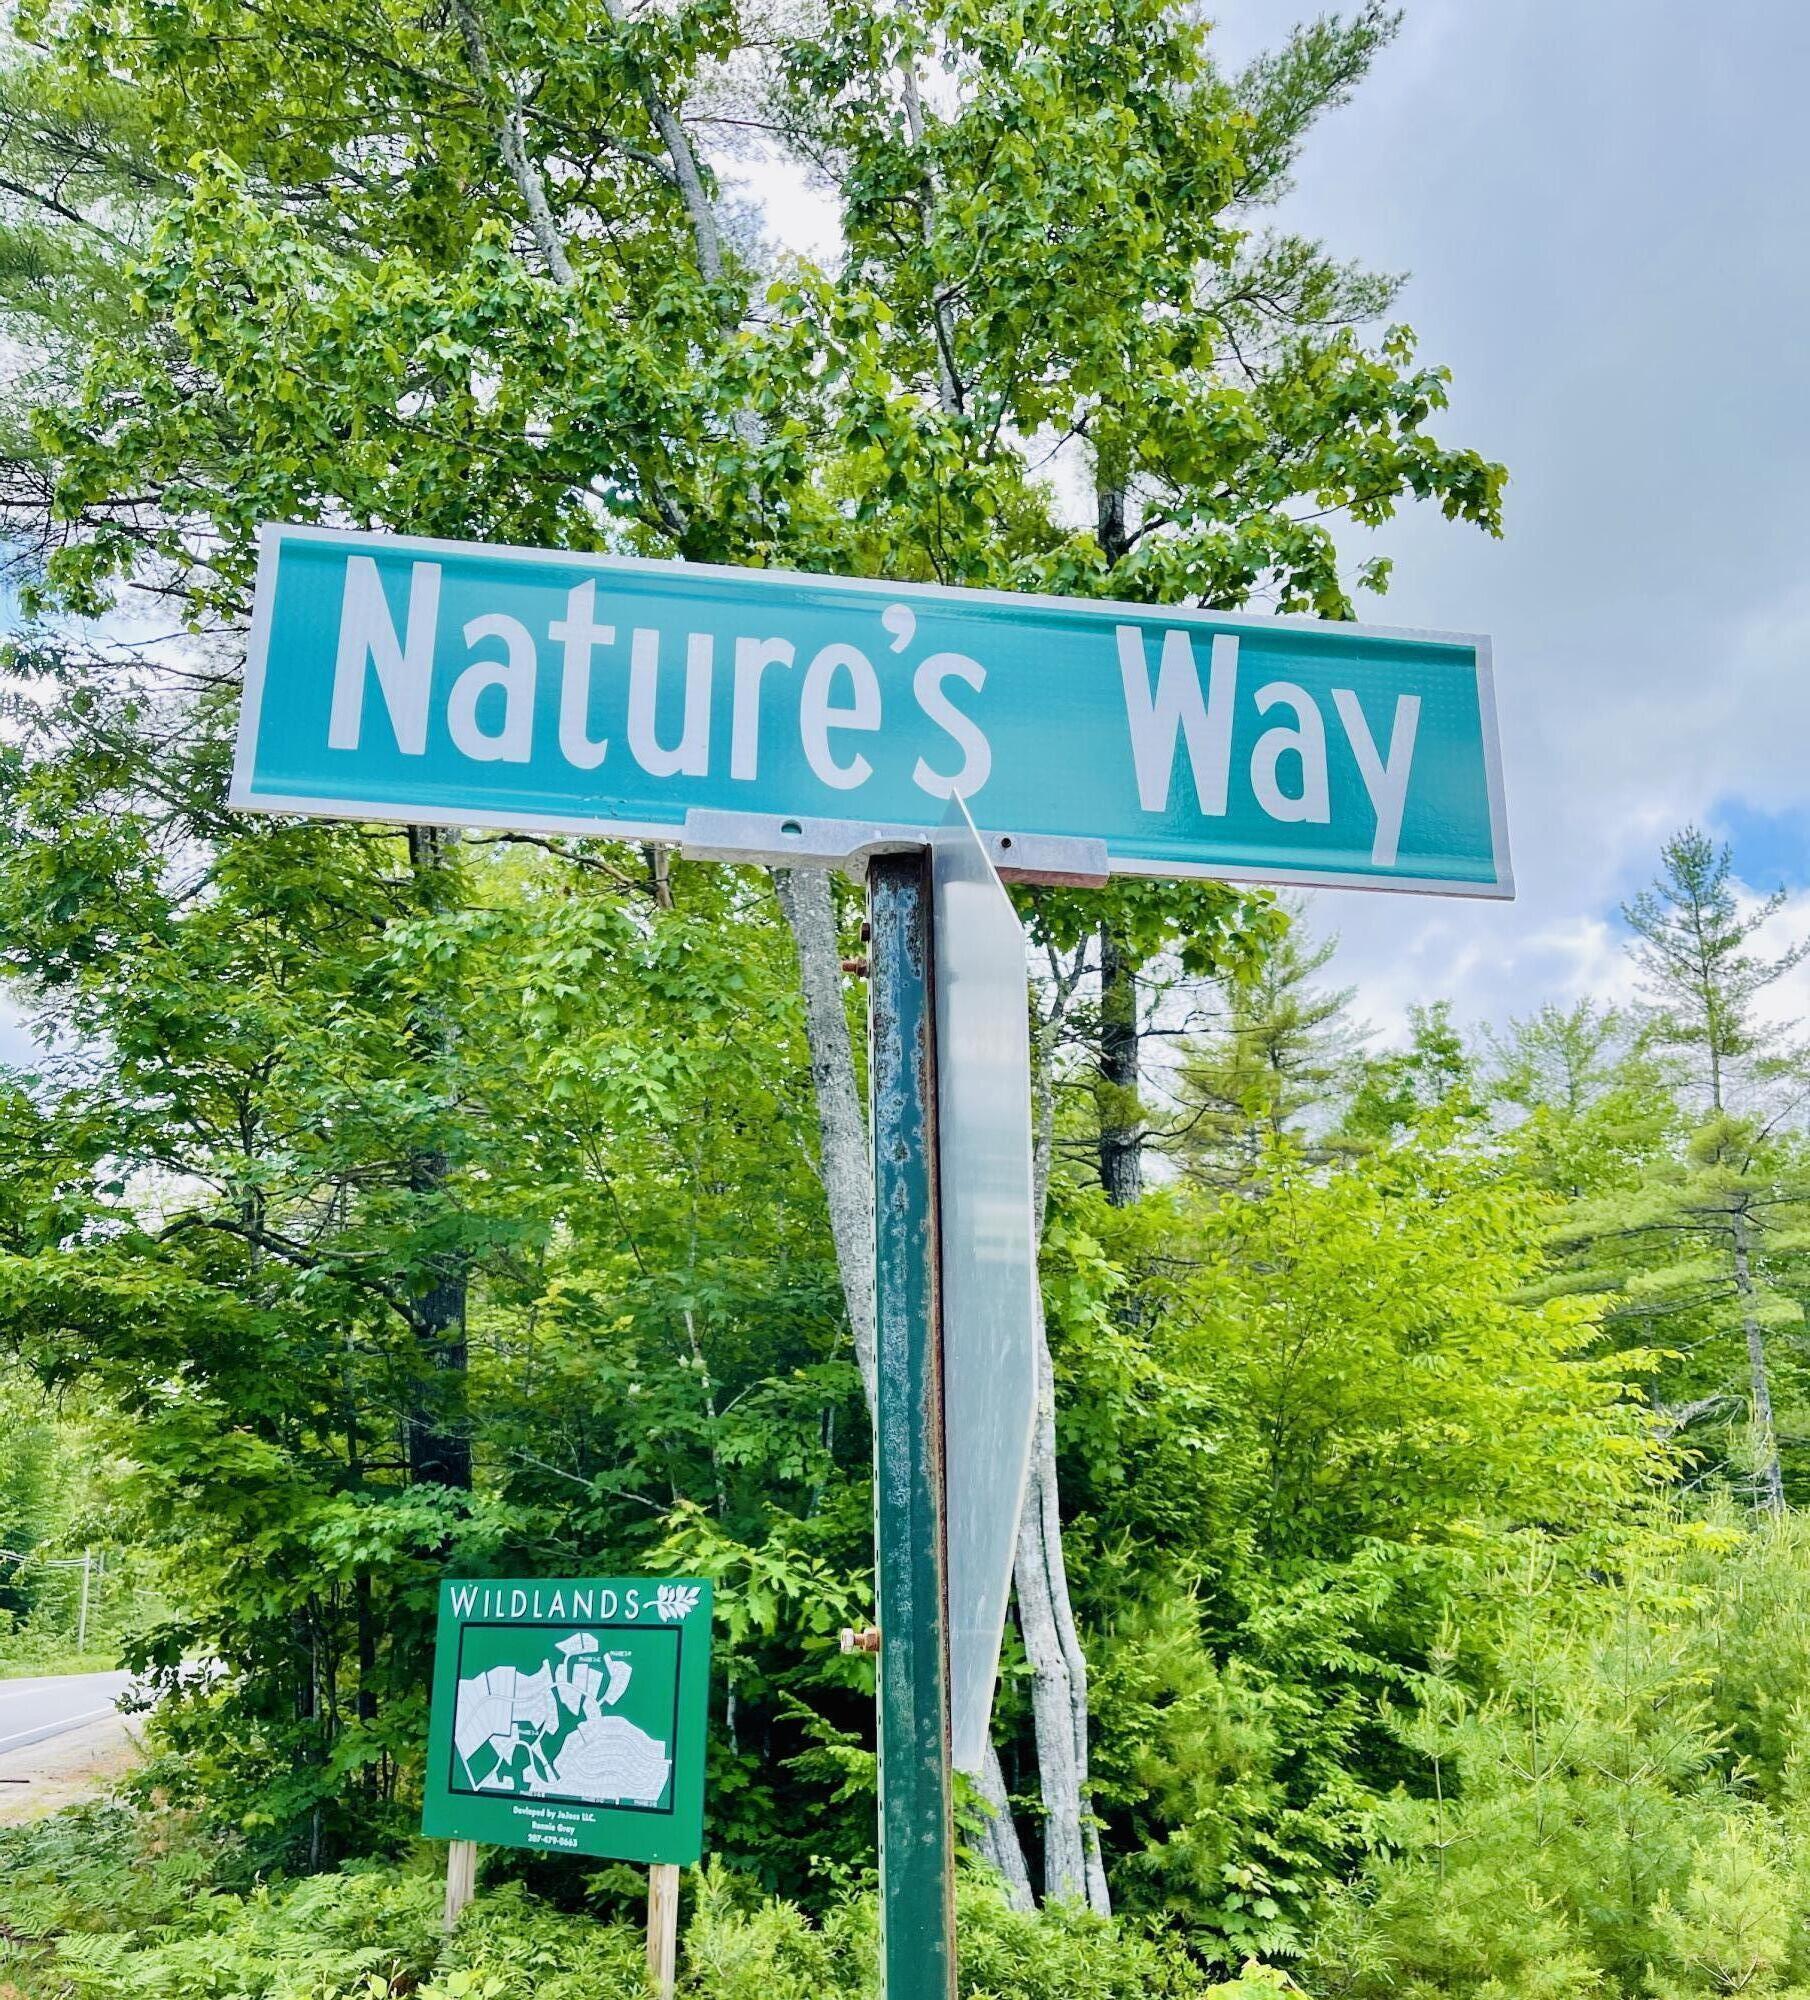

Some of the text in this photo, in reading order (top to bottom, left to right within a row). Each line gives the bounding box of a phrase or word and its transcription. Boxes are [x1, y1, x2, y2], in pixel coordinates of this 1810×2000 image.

[328, 555, 1421, 866] Nature's Way
[450, 1584, 640, 1620] WILDLANDS
[545, 1808, 556, 1820] by
[581, 1812, 597, 1822] LLC.
